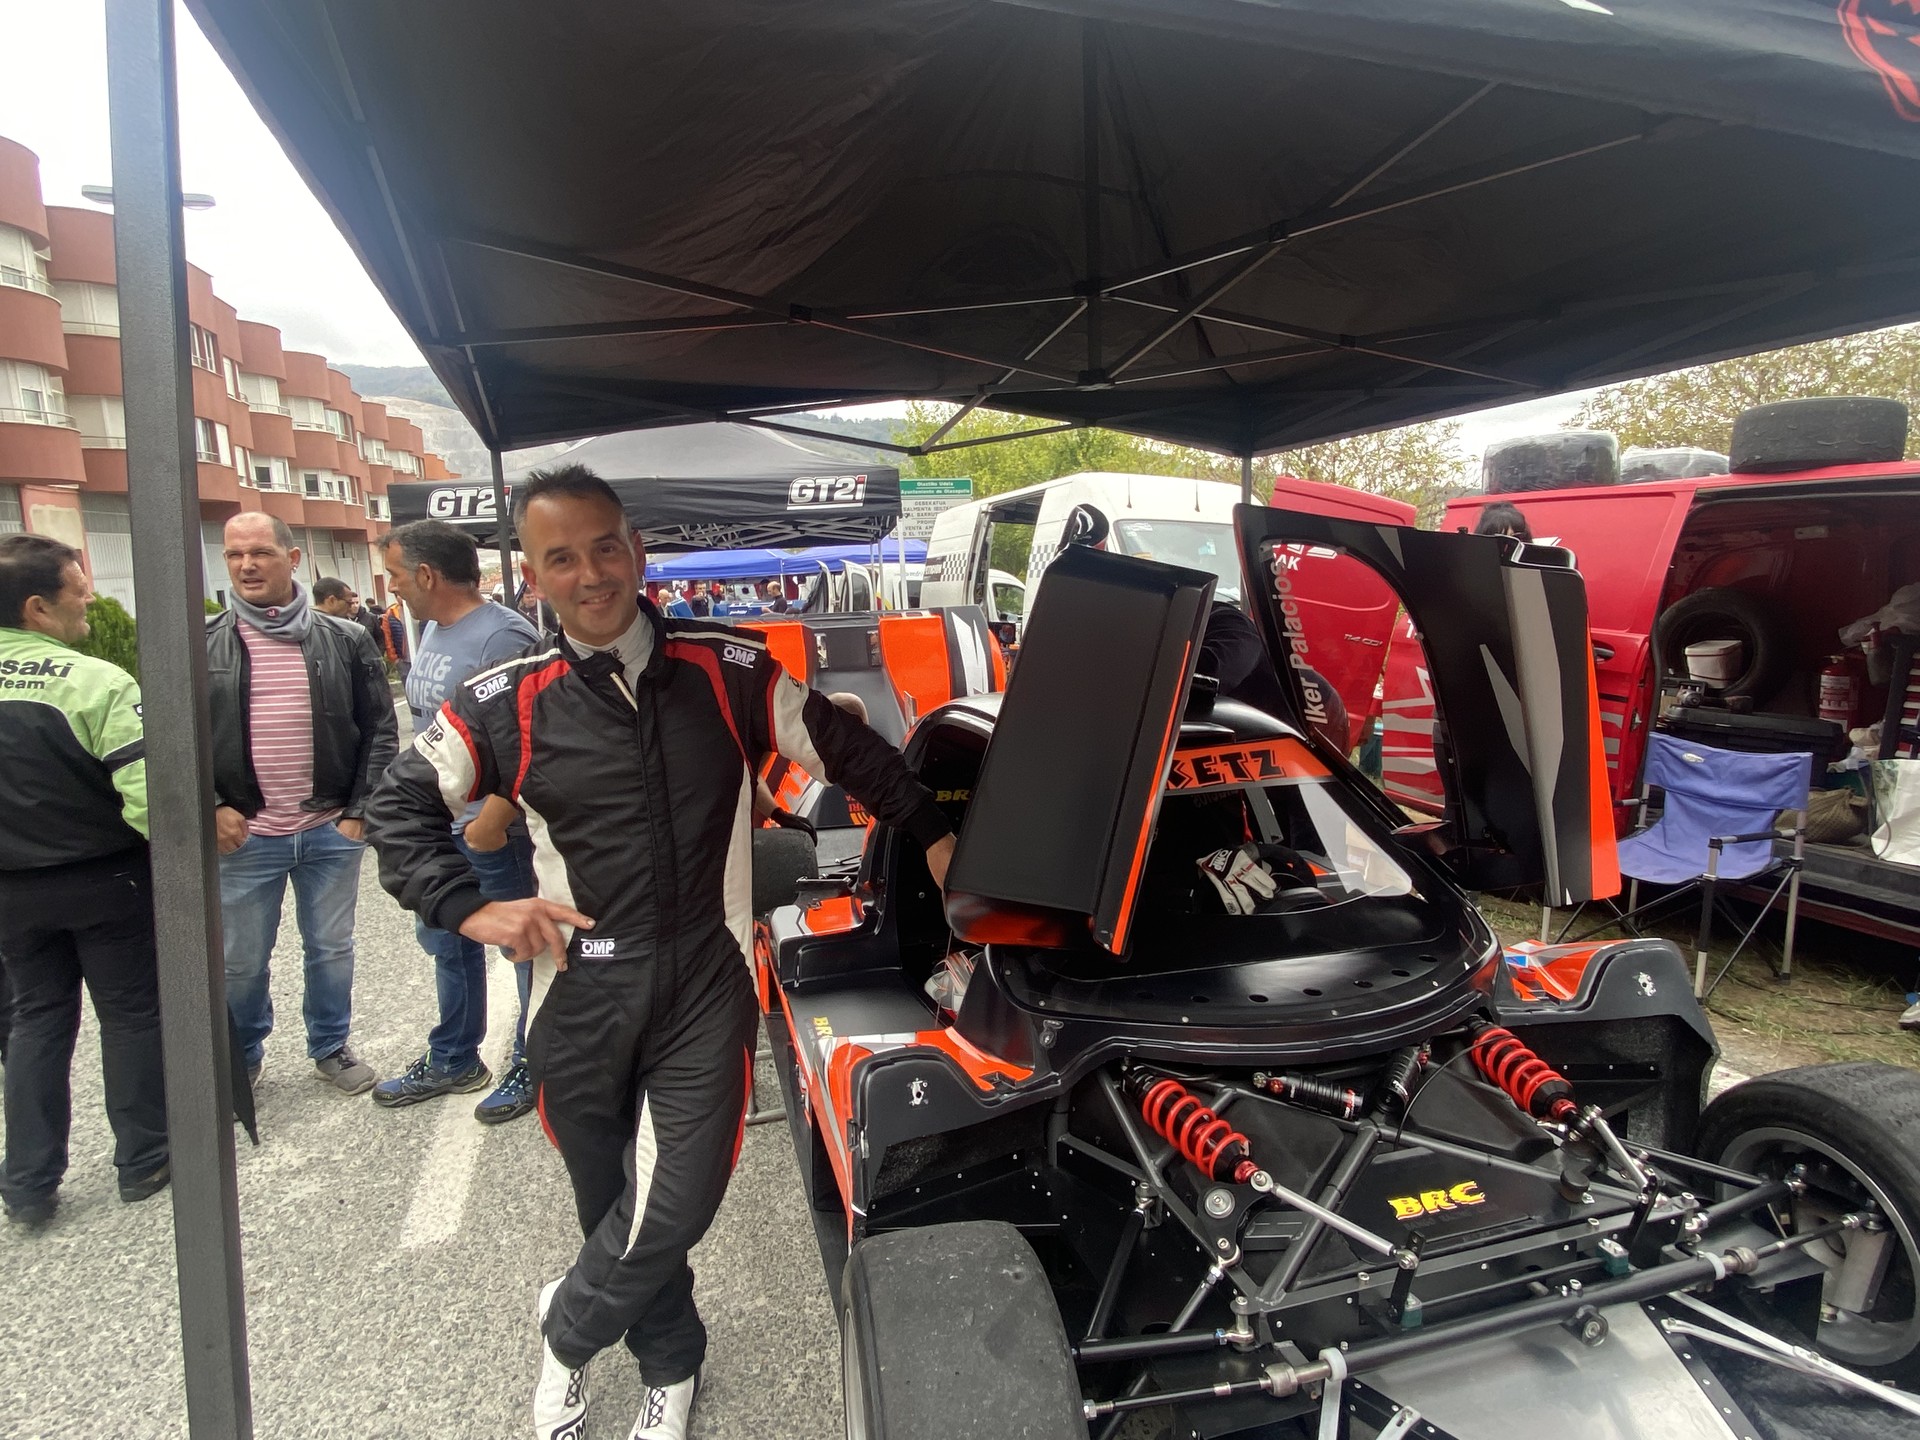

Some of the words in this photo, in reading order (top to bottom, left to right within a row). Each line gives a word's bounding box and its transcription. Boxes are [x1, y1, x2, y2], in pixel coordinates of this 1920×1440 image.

[788, 476, 867, 505] GT2i
[1270, 561, 1314, 670] Palacios
[724, 645, 756, 665] OMP
[0, 658, 74, 679] saki
[474, 674, 509, 700] OMP
[1303, 676, 1328, 725] Iker
[426, 724, 445, 744] MP
[1167, 749, 1286, 789] KETZ
[935, 789, 970, 802] BR
[581, 940, 616, 955] OMP
[813, 1016, 834, 1040] BR
[1387, 1181, 1485, 1220] BRC
[561, 1418, 588, 1440] OM
